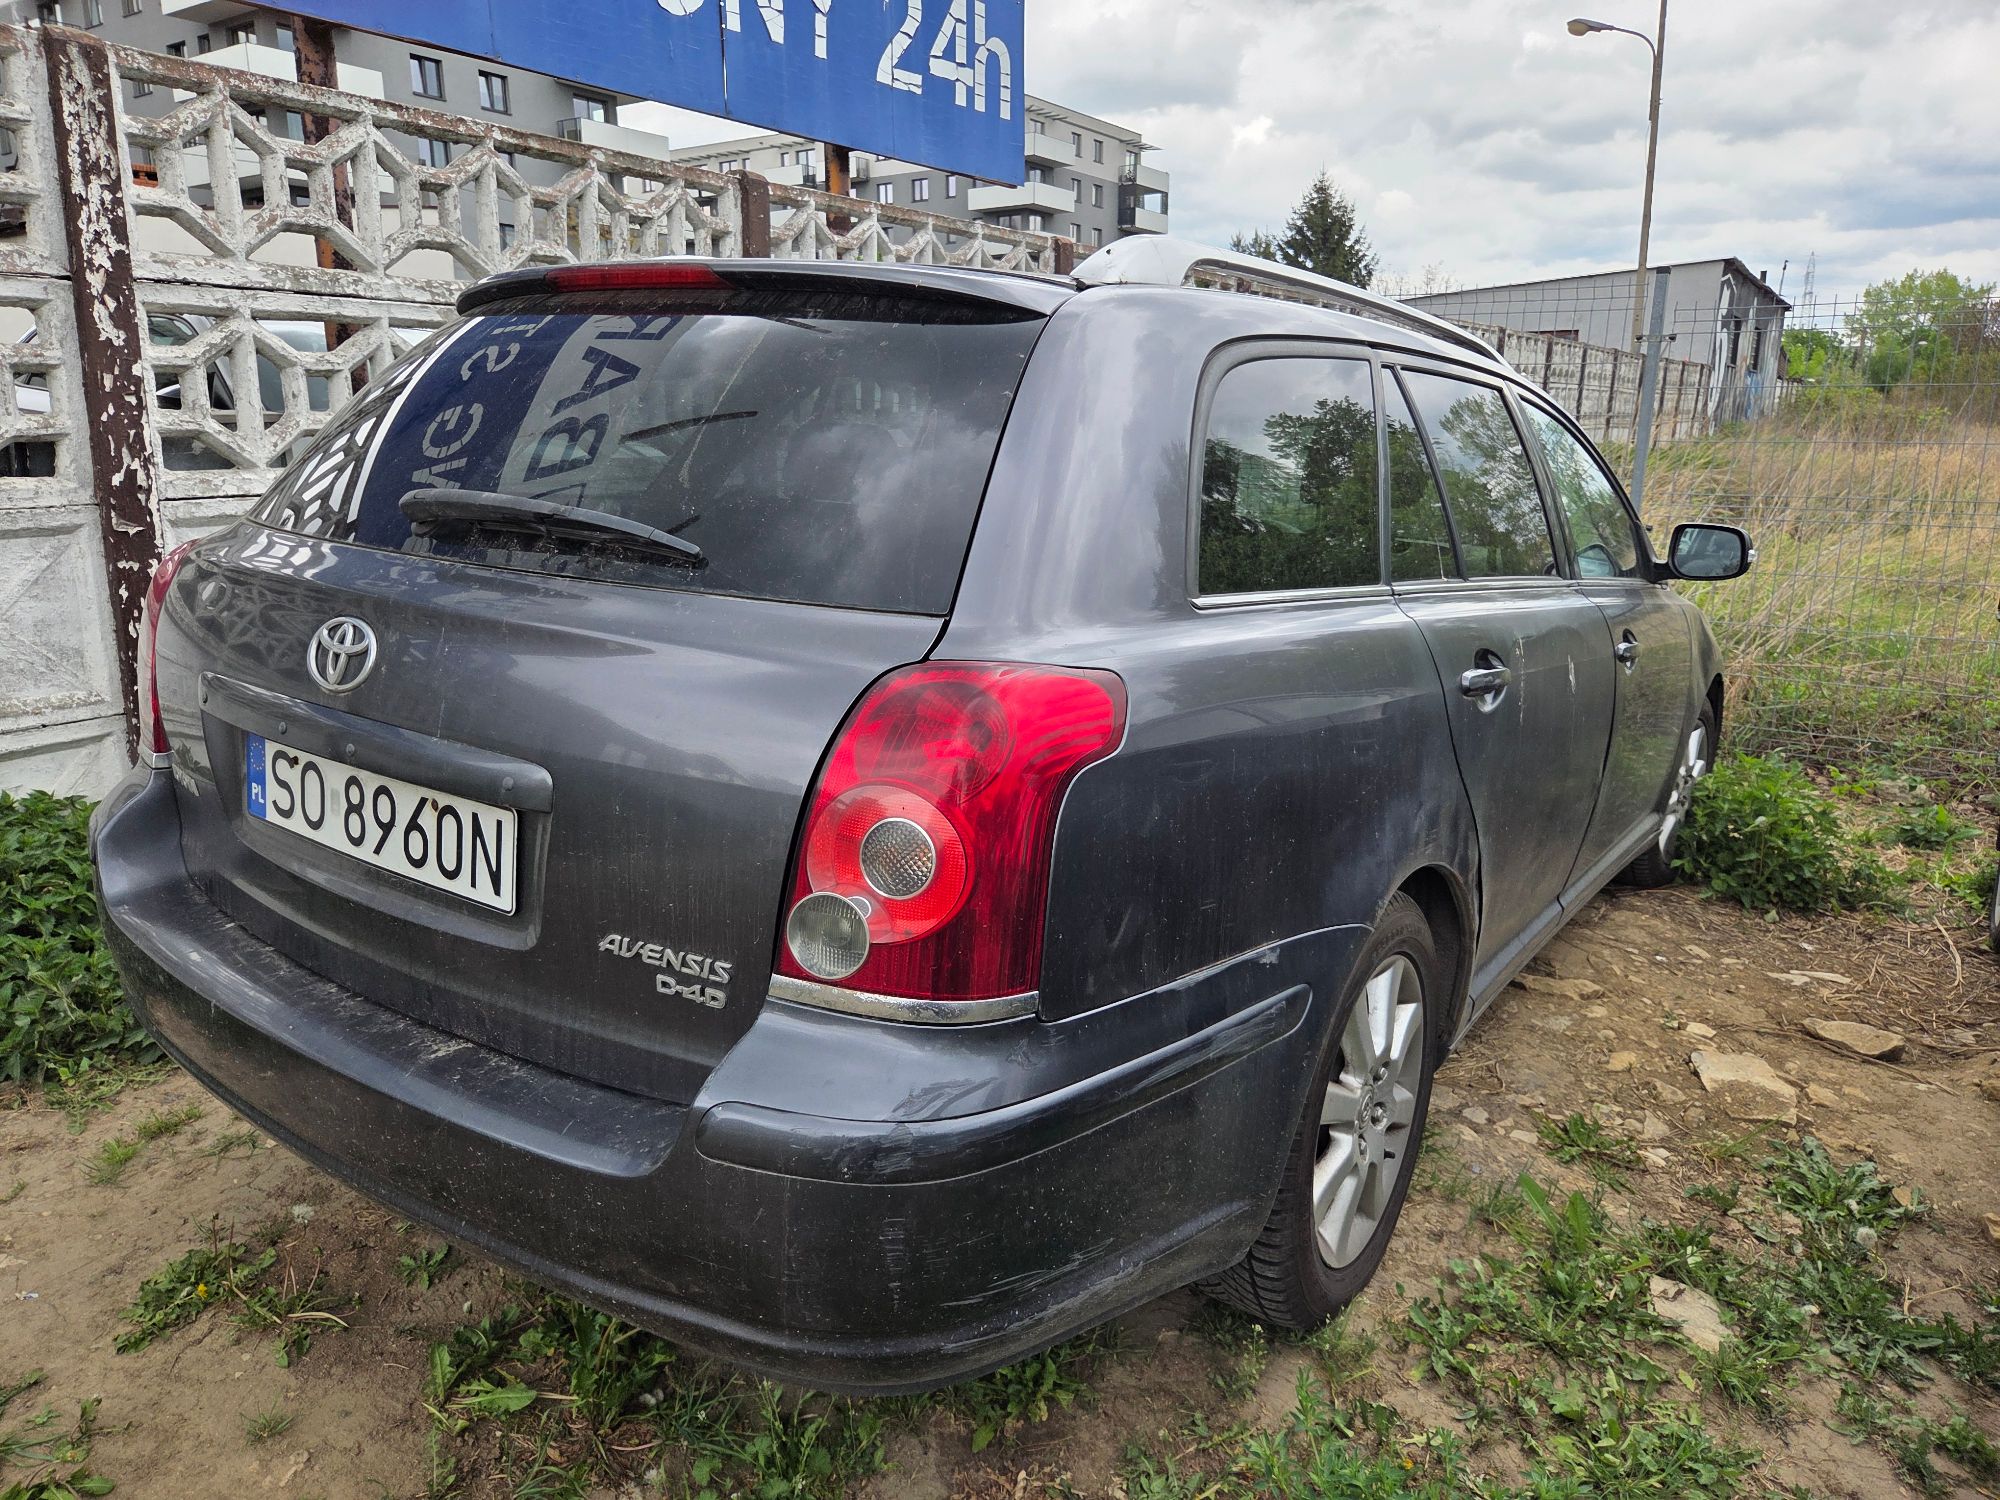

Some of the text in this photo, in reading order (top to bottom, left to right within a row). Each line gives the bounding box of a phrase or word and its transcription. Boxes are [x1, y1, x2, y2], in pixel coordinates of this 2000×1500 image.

[876, 0, 1011, 121] 24h
[251, 782, 265, 804] PL
[271, 749, 326, 831] SO
[598, 934, 733, 984] AVENSIS
[655, 973, 727, 1009] D-4D
